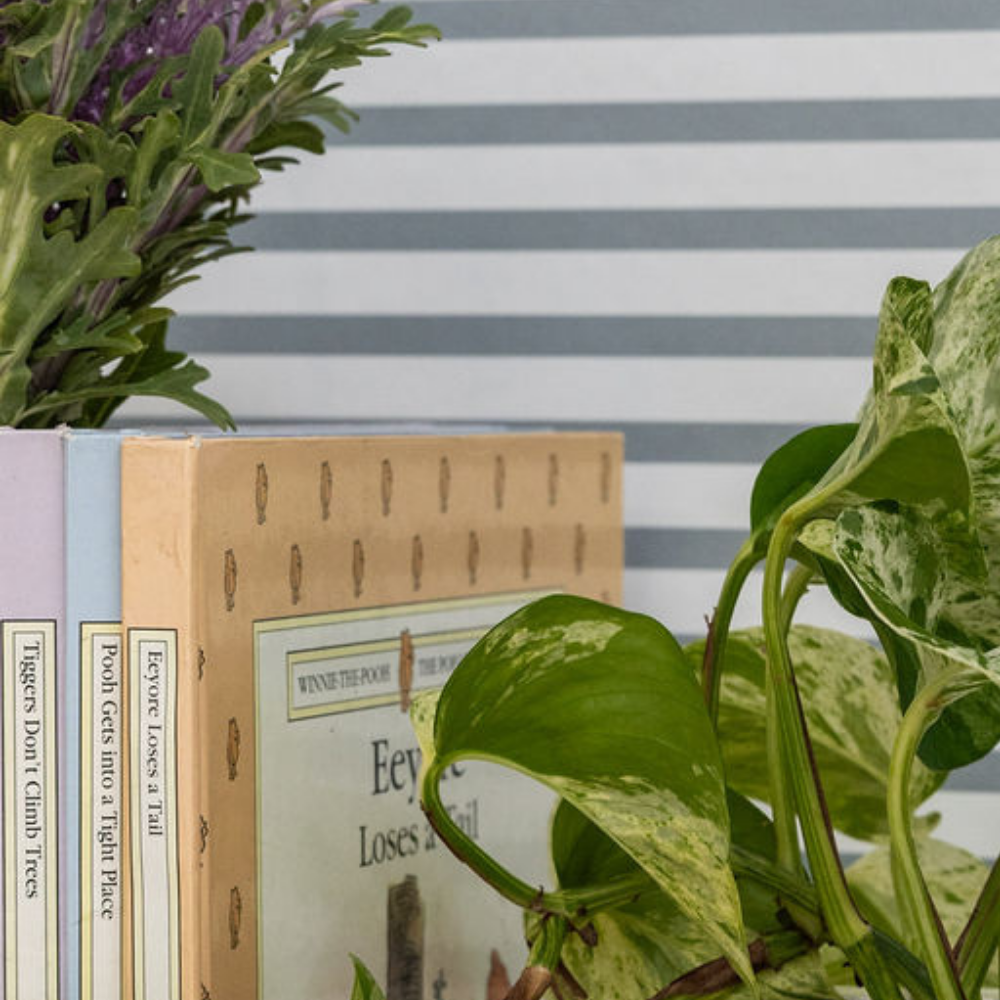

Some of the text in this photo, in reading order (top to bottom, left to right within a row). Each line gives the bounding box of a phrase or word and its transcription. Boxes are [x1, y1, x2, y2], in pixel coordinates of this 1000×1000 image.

[19, 641, 42, 899] Tiggers Don't Climb Trees
[97, 643, 118, 920] Pooh Gets into a Tight Place
[143, 651, 163, 836] Eeyore Loses a Tail
[360, 824, 418, 867] Loses
